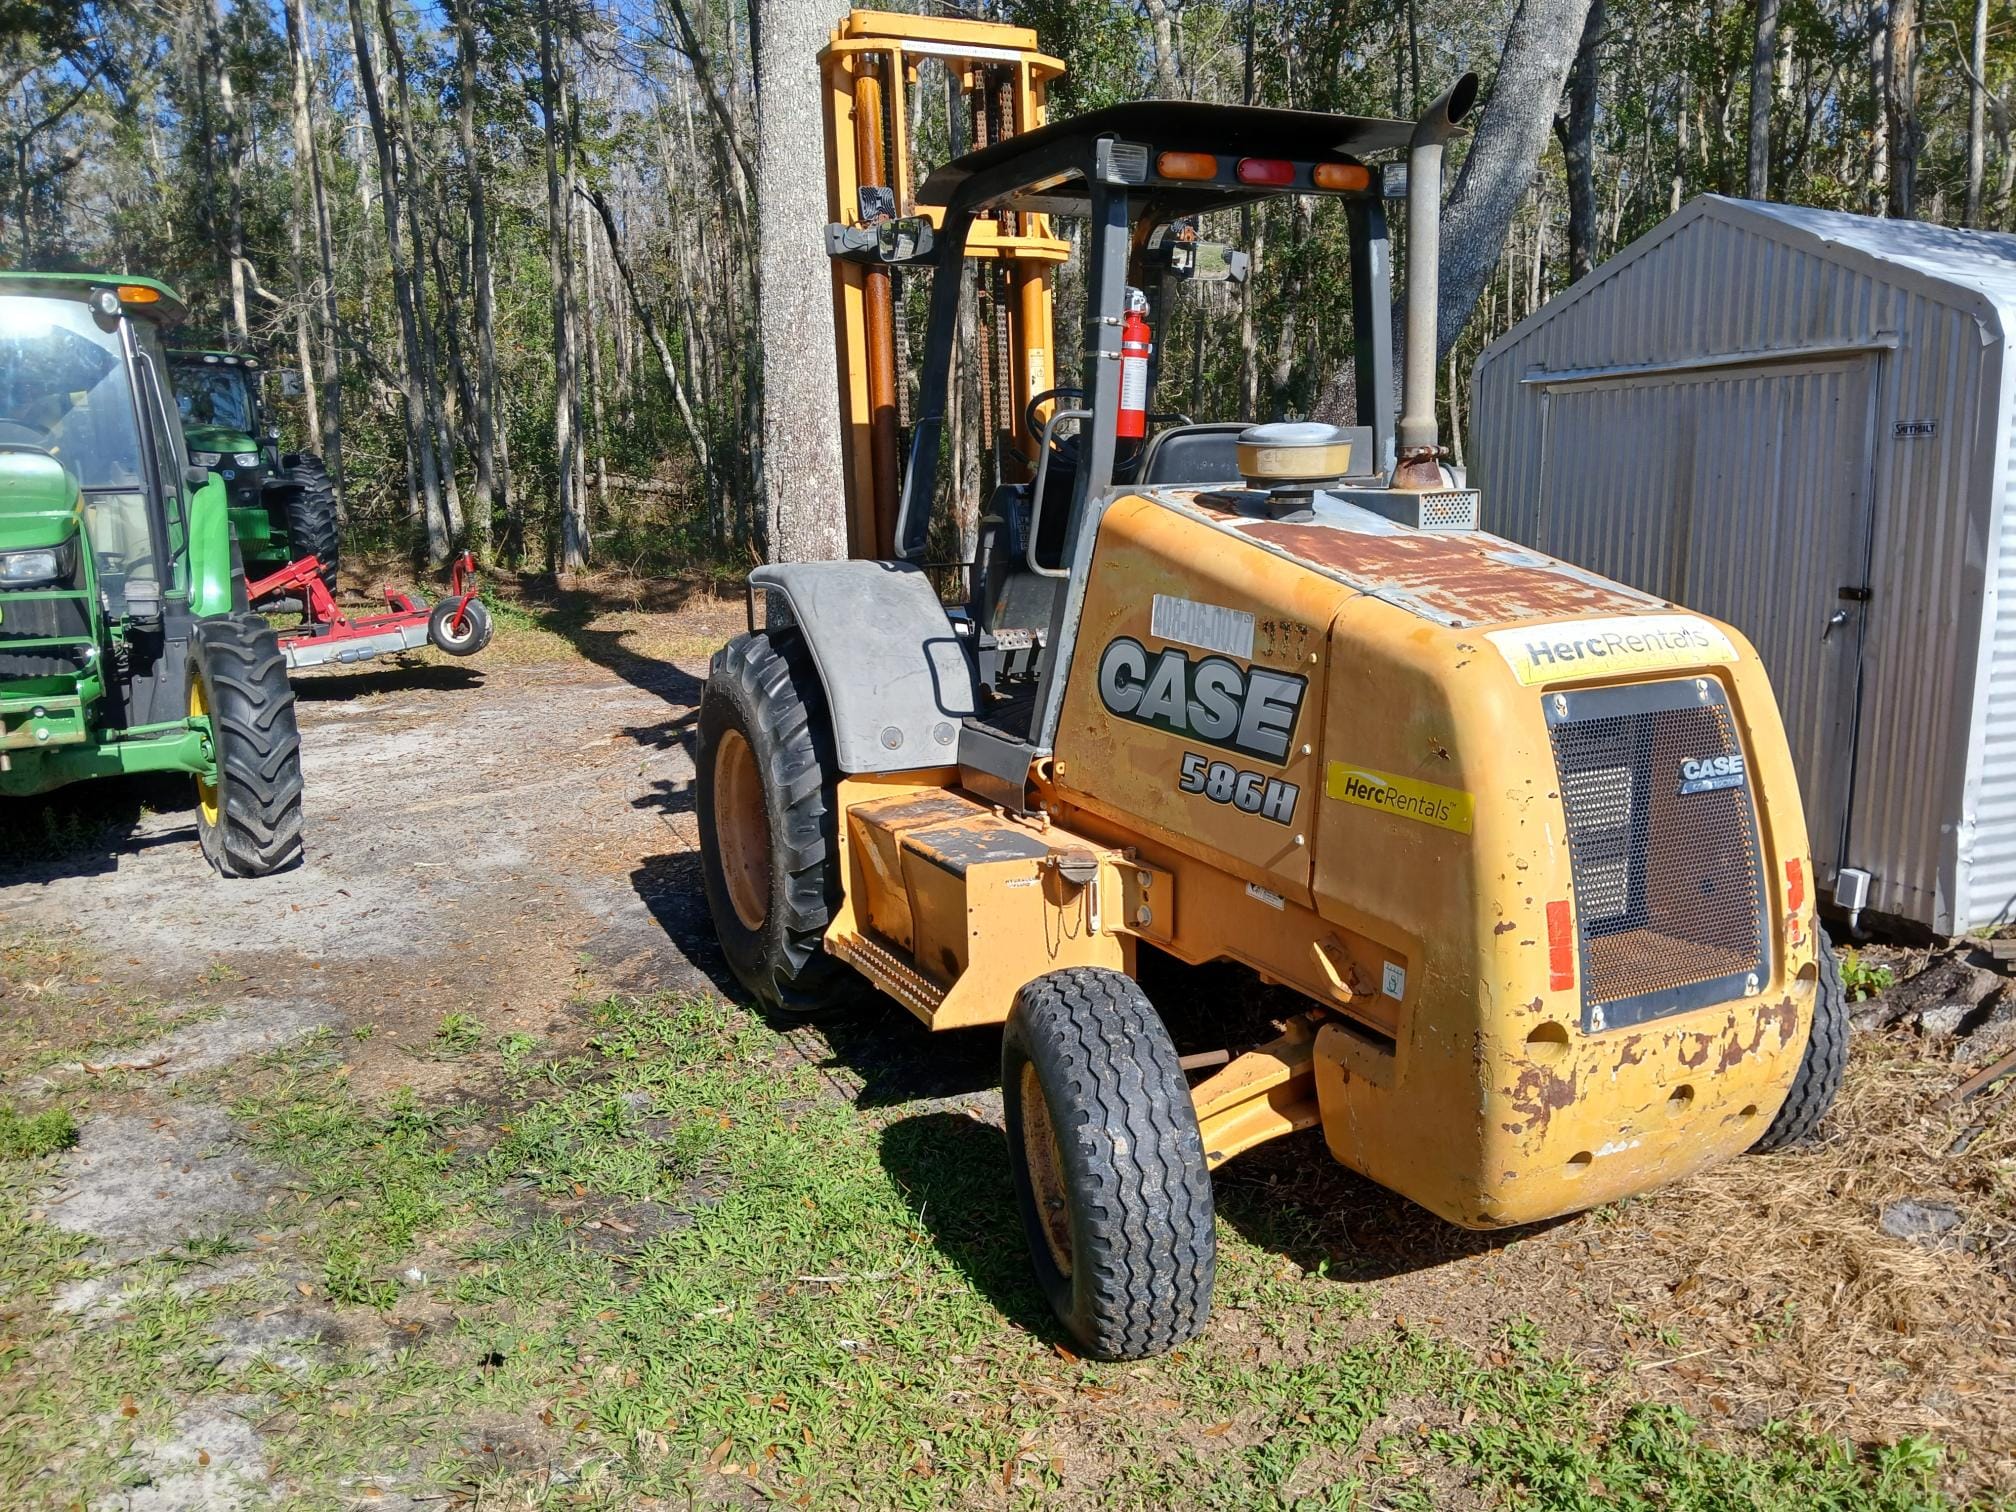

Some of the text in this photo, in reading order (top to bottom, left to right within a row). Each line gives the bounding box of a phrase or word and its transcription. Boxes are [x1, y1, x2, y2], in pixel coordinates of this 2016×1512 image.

[1525, 627, 1710, 667] HercRentals
[1099, 637, 1306, 766] CASE
[1178, 752, 1300, 827] 586H
[1683, 755, 1744, 780] CASE
